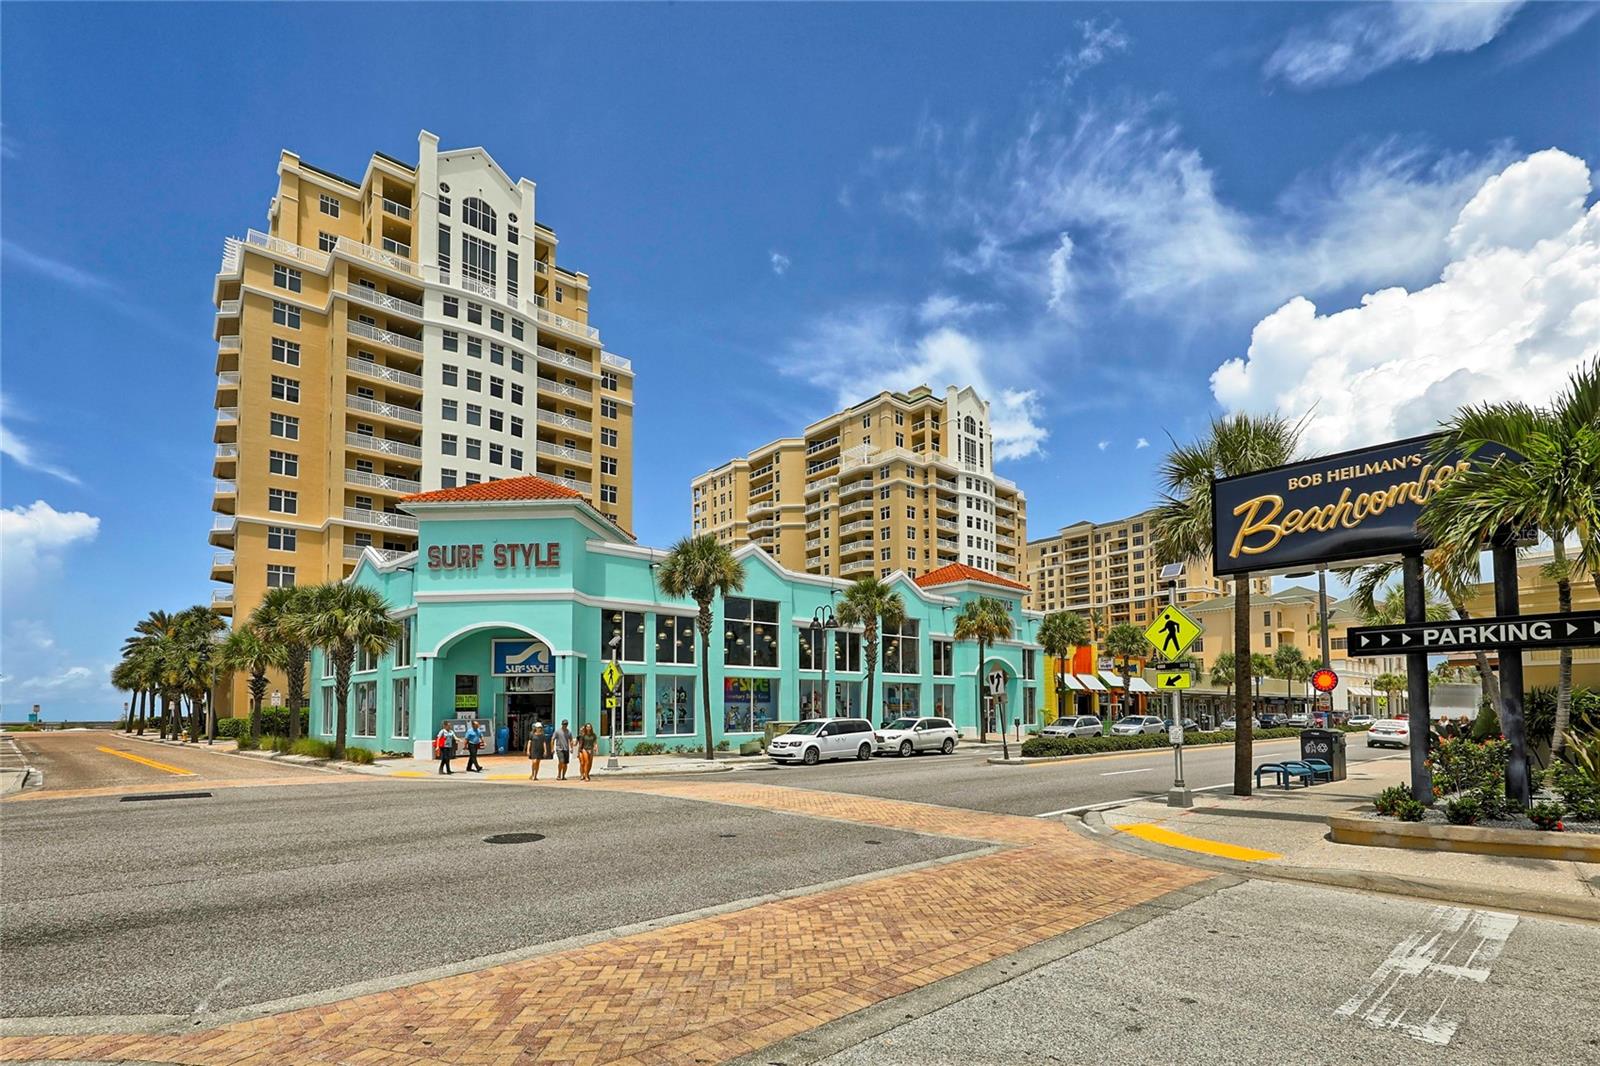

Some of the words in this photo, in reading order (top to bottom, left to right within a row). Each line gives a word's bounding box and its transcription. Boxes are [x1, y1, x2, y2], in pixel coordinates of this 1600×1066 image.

[1288, 473, 1322, 490] BOB
[1327, 453, 1422, 482] HEILMAN'S
[427, 543, 484, 570] SURF
[493, 542, 561, 569] STYLE
[1423, 621, 1552, 646] PARKING
